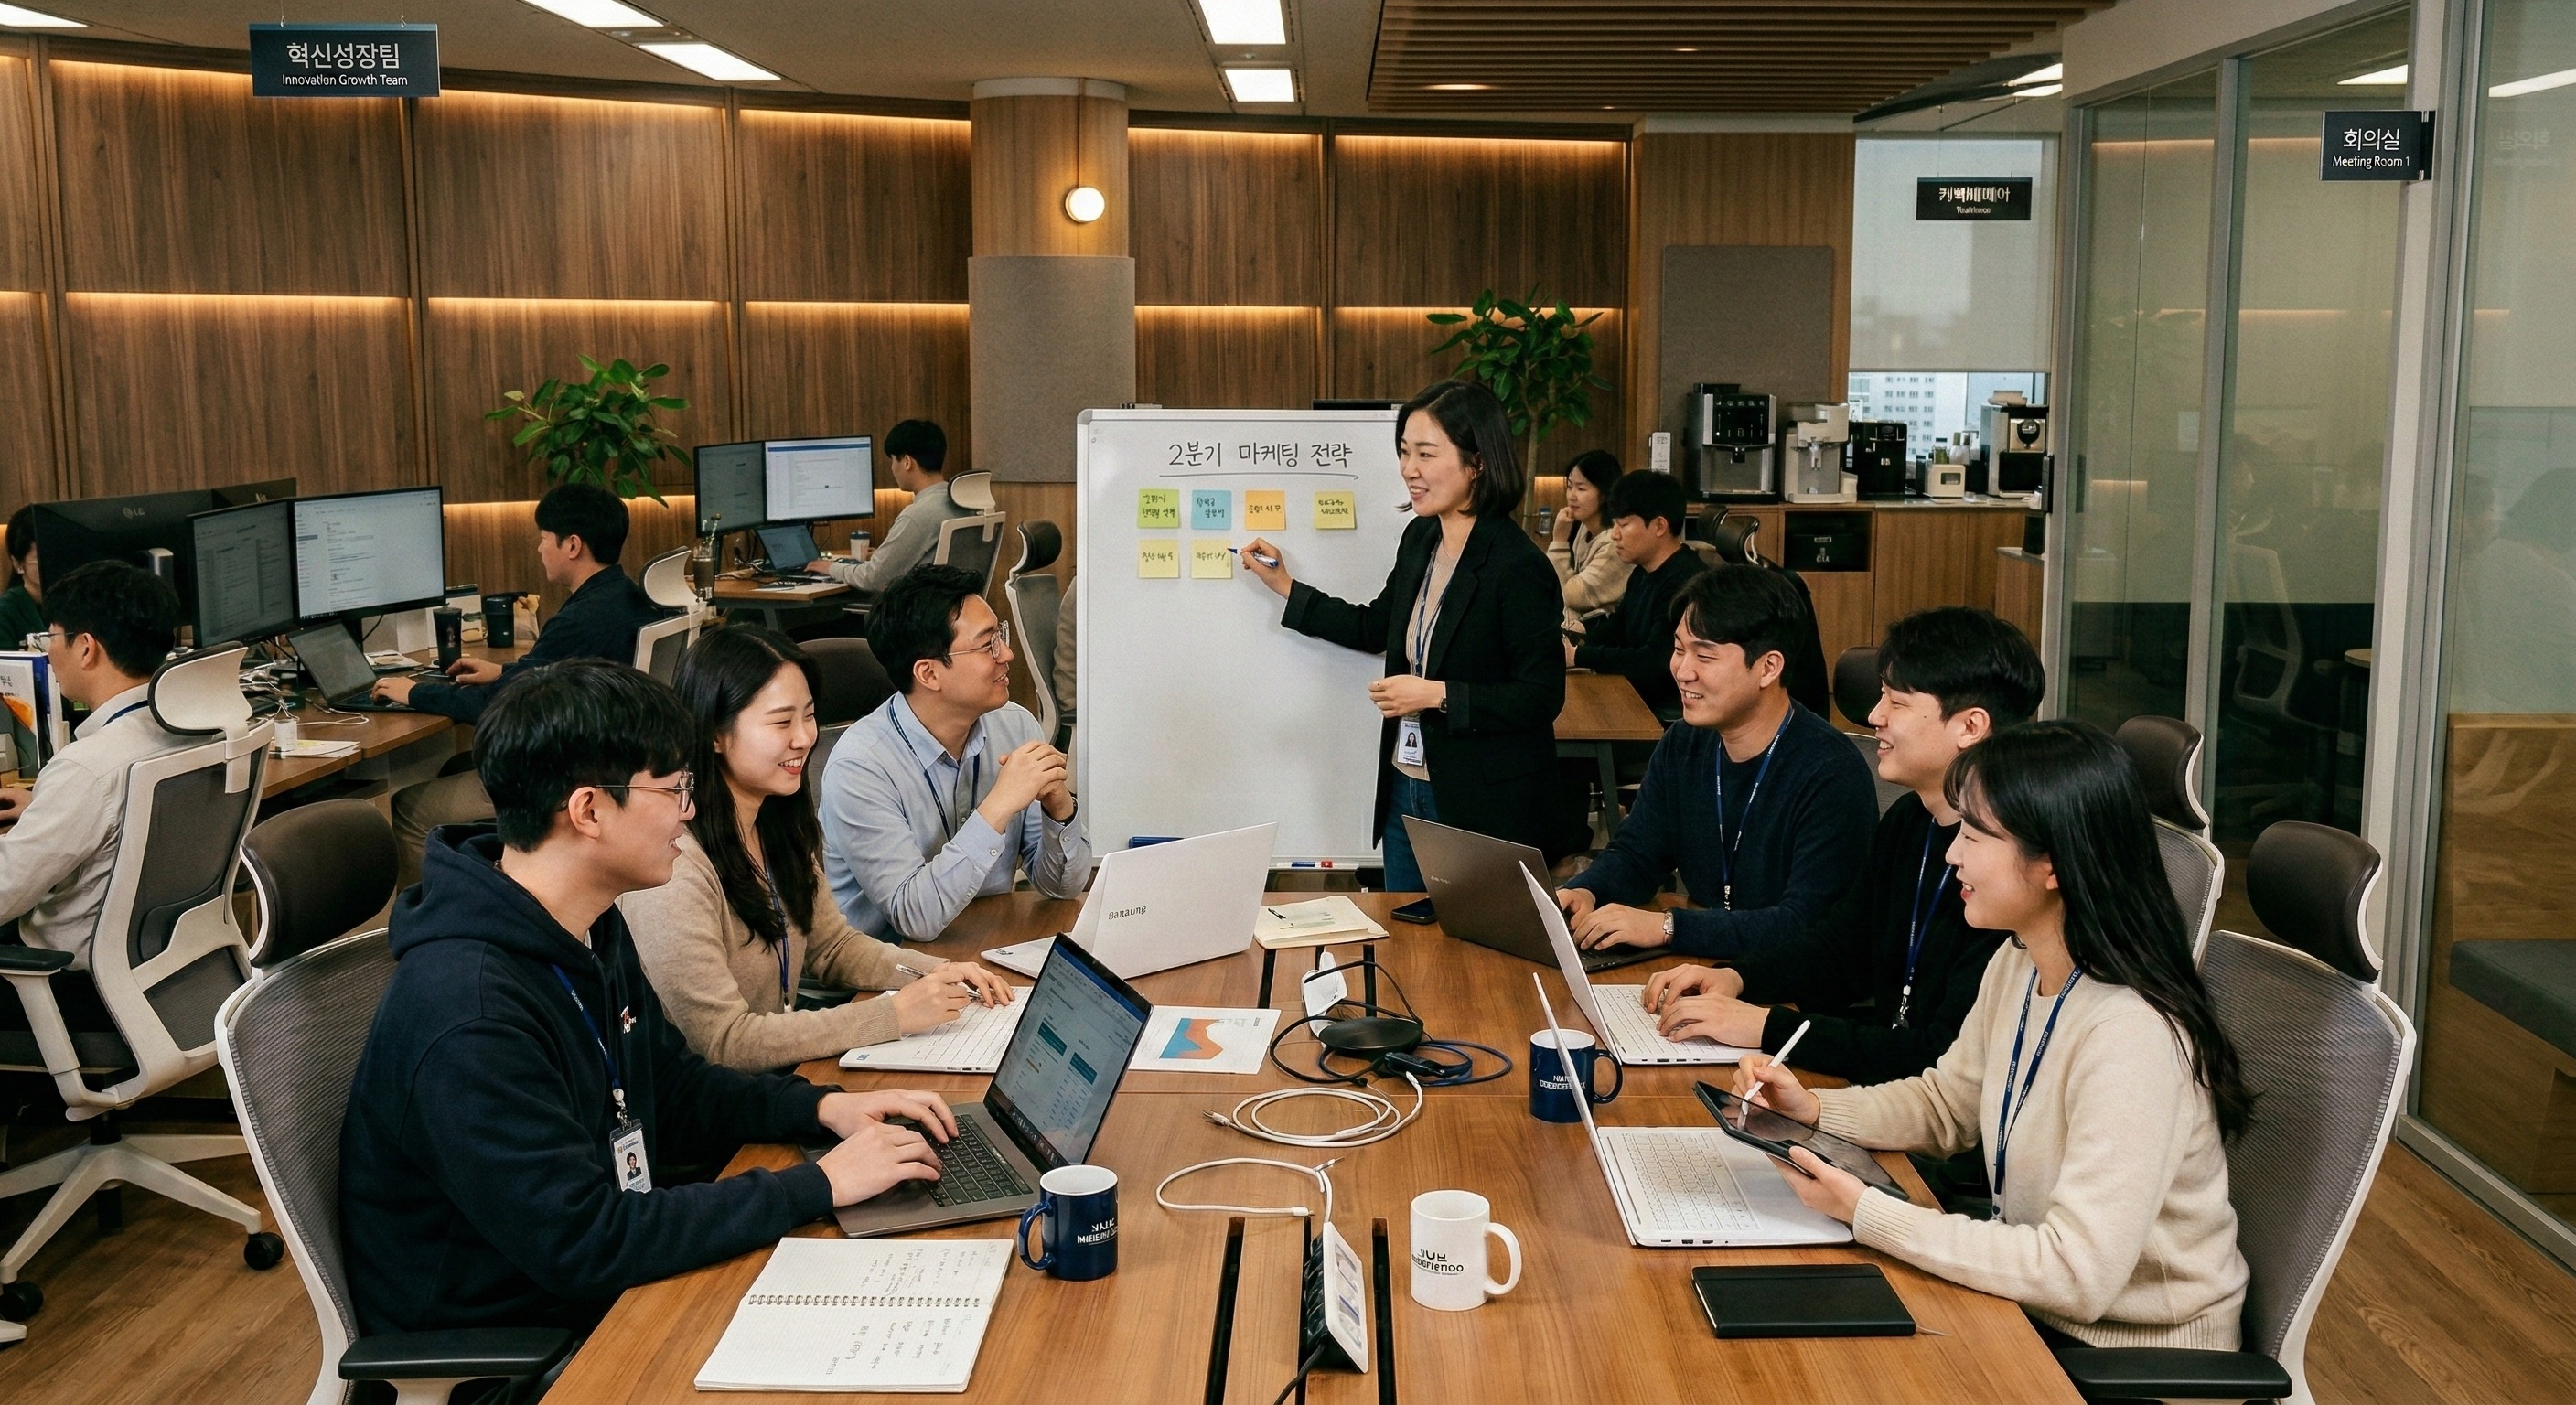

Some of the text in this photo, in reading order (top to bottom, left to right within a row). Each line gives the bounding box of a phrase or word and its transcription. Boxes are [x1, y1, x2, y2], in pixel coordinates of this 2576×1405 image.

[286, 42, 400, 70] 혁신성장팀
[282, 73, 409, 86] Innovation Growth Team
[2343, 128, 2400, 151] 회의실
[2333, 156, 2410, 170] Meeting Room 1
[1168, 441, 1353, 469] 2분기 마케팅 전략
